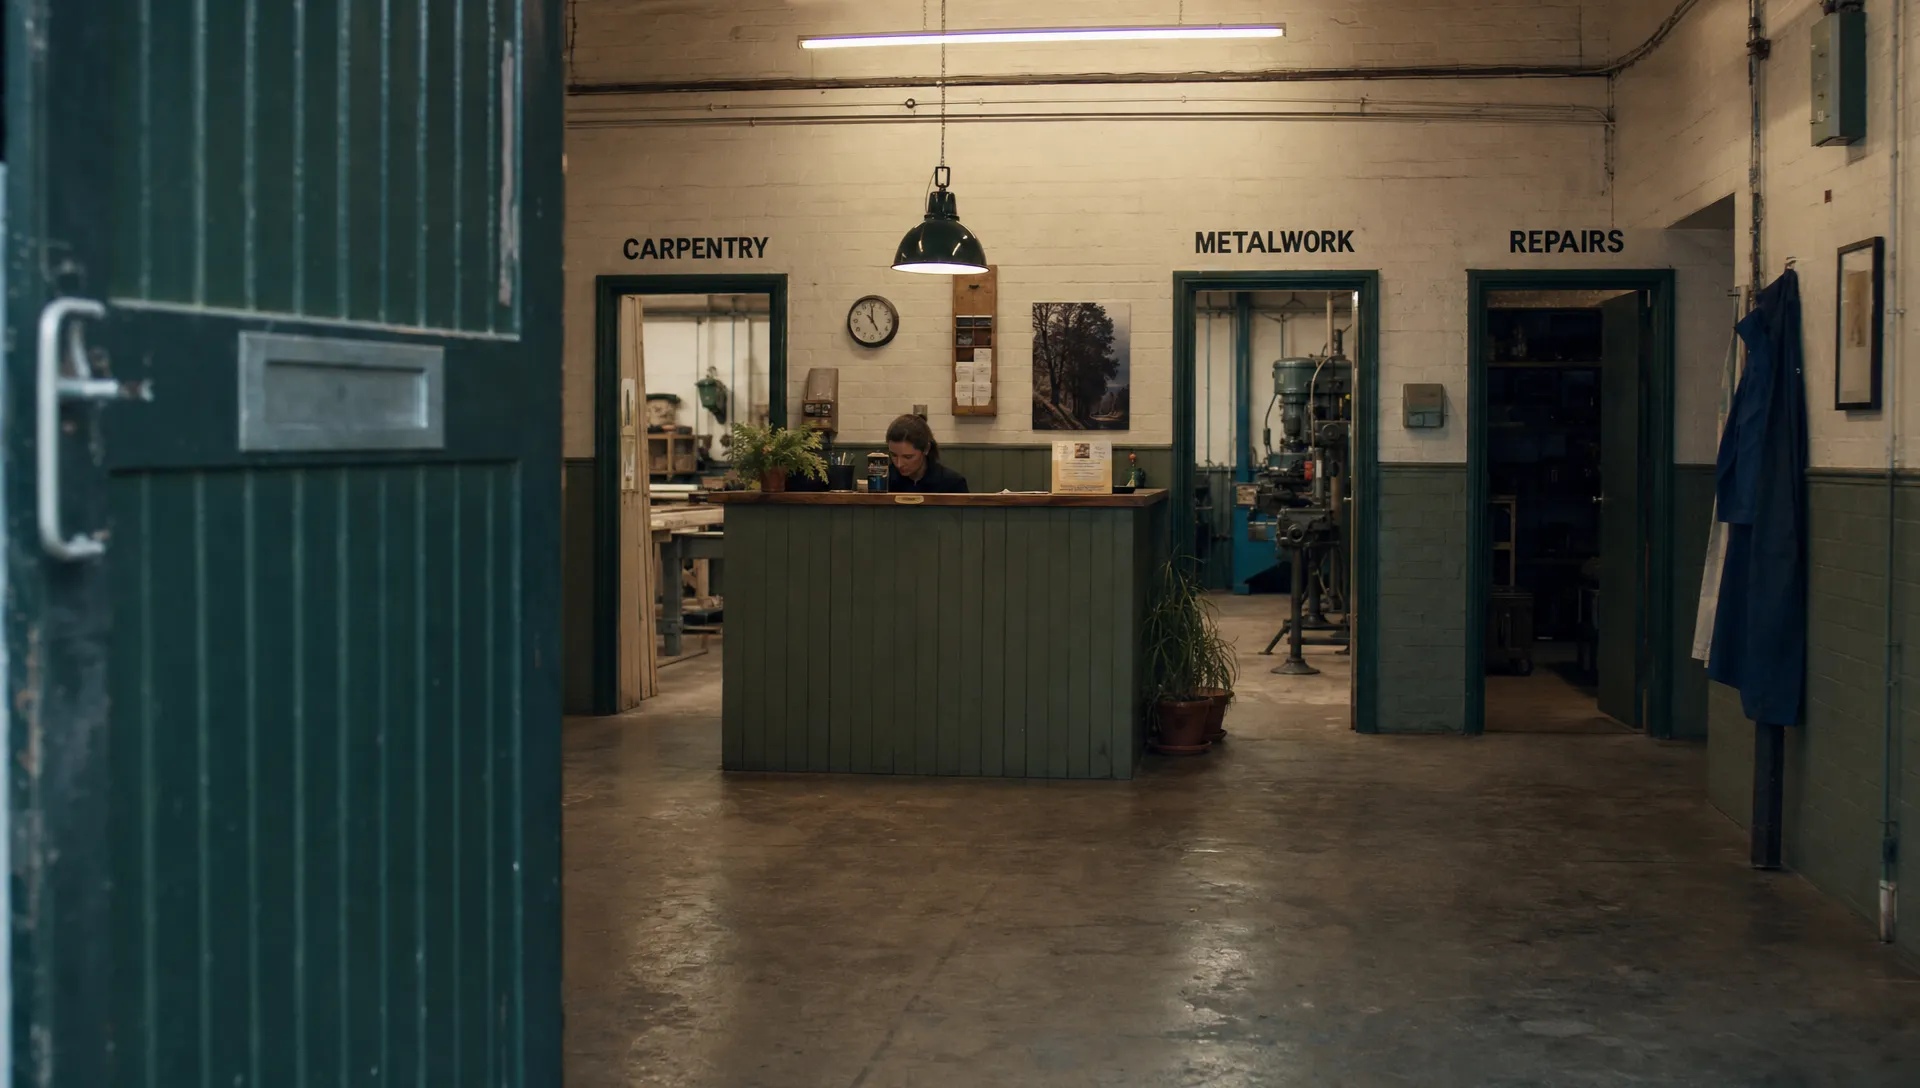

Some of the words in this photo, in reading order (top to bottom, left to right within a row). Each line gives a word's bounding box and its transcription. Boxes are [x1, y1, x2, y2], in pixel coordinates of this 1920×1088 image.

[622, 236, 769, 261] CARPENTRY
[1195, 229, 1356, 254] METALWORK
[1510, 229, 1624, 254] REPAIRS
